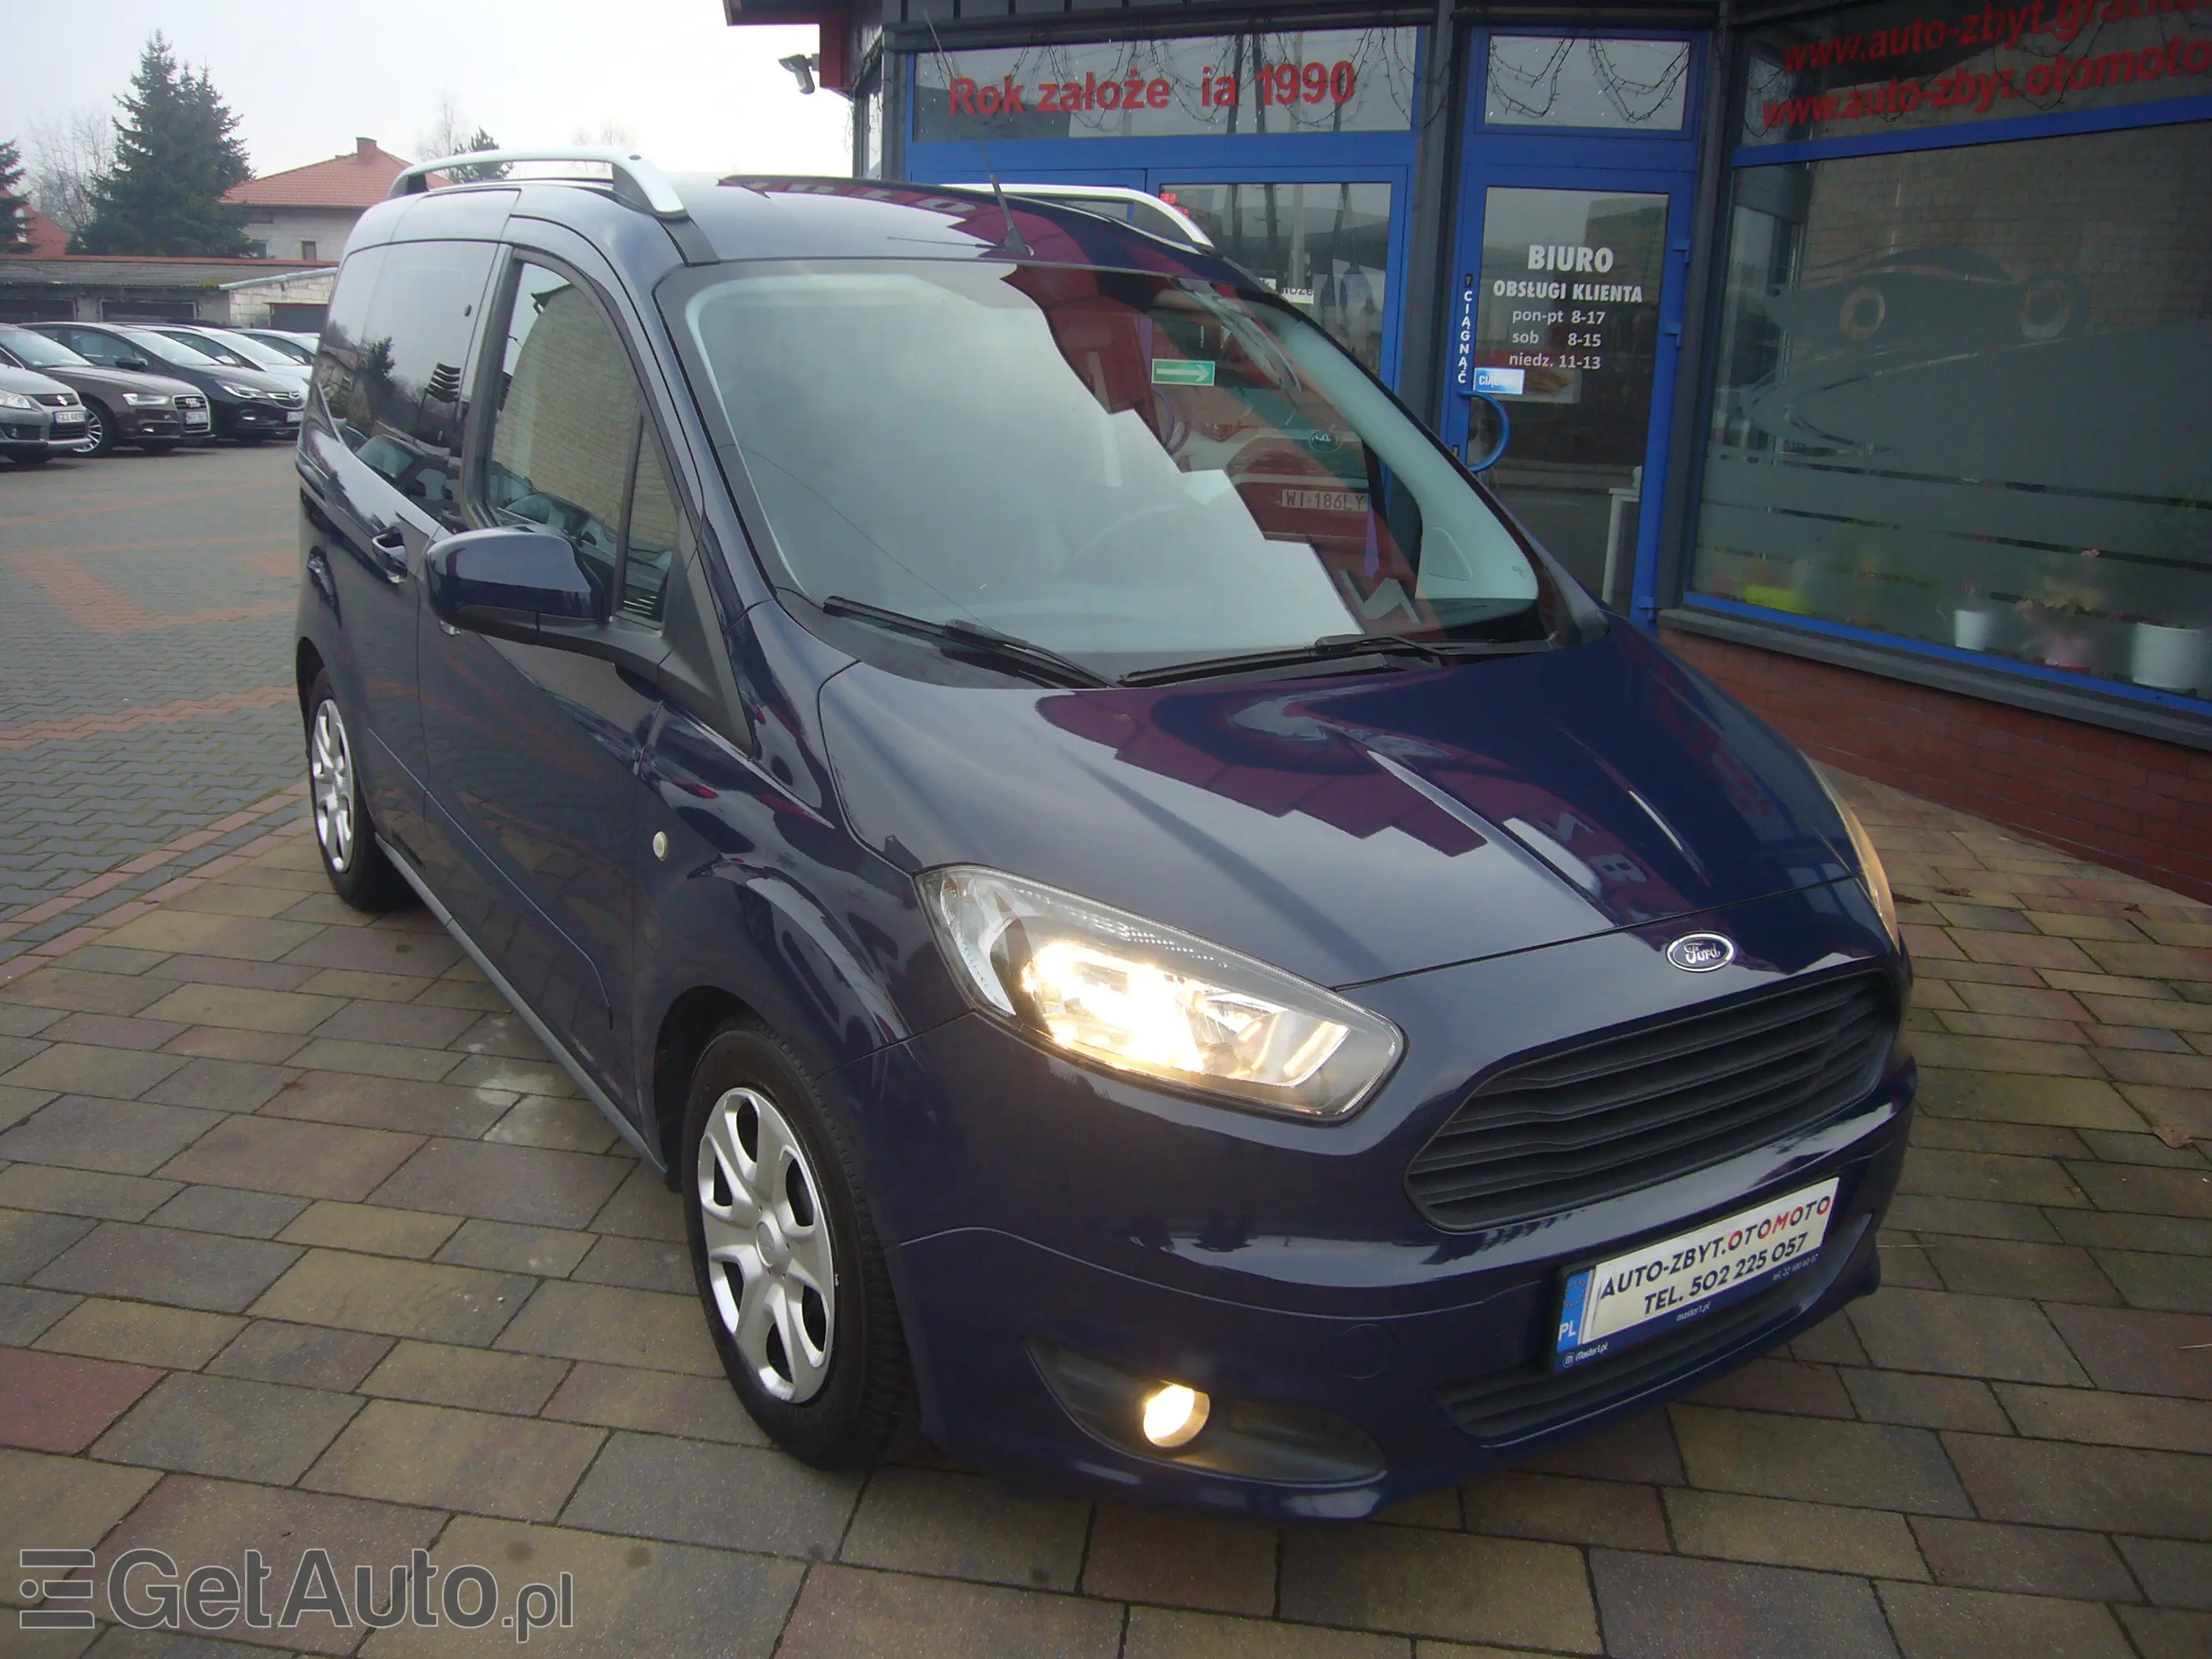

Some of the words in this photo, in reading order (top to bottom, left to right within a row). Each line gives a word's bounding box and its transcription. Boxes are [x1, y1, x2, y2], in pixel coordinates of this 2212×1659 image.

[948, 75, 1026, 116] Rok
[1255, 60, 1357, 106] 1990
[1527, 244, 1614, 273] BIURO
[1493, 280, 1567, 300] OBSŁUGI
[1572, 283, 1643, 303] KLIENTA
[1512, 309, 1564, 326] pon-pt
[1571, 309, 1606, 325] 8-17
[1457, 290, 1473, 383] CIĄGNĄĆ
[1512, 330, 1540, 344] sob
[1567, 332, 1602, 347] 8-15
[1508, 352, 1554, 368] niedz.
[1558, 354, 1601, 369] 11-13
[1286, 491, 1304, 507] WI
[1314, 493, 1365, 511] 186LY
[1683, 942, 1721, 965] Ford
[1600, 1195, 1831, 1300] AUTO-ZBYT.OTOMOTO
[1644, 1285, 1683, 1314] TEL.
[1689, 1265, 1730, 1297] 502
[1733, 1249, 1767, 1280] 225
[1771, 1231, 1810, 1262] 057
[1558, 1320, 1577, 1342] PL
